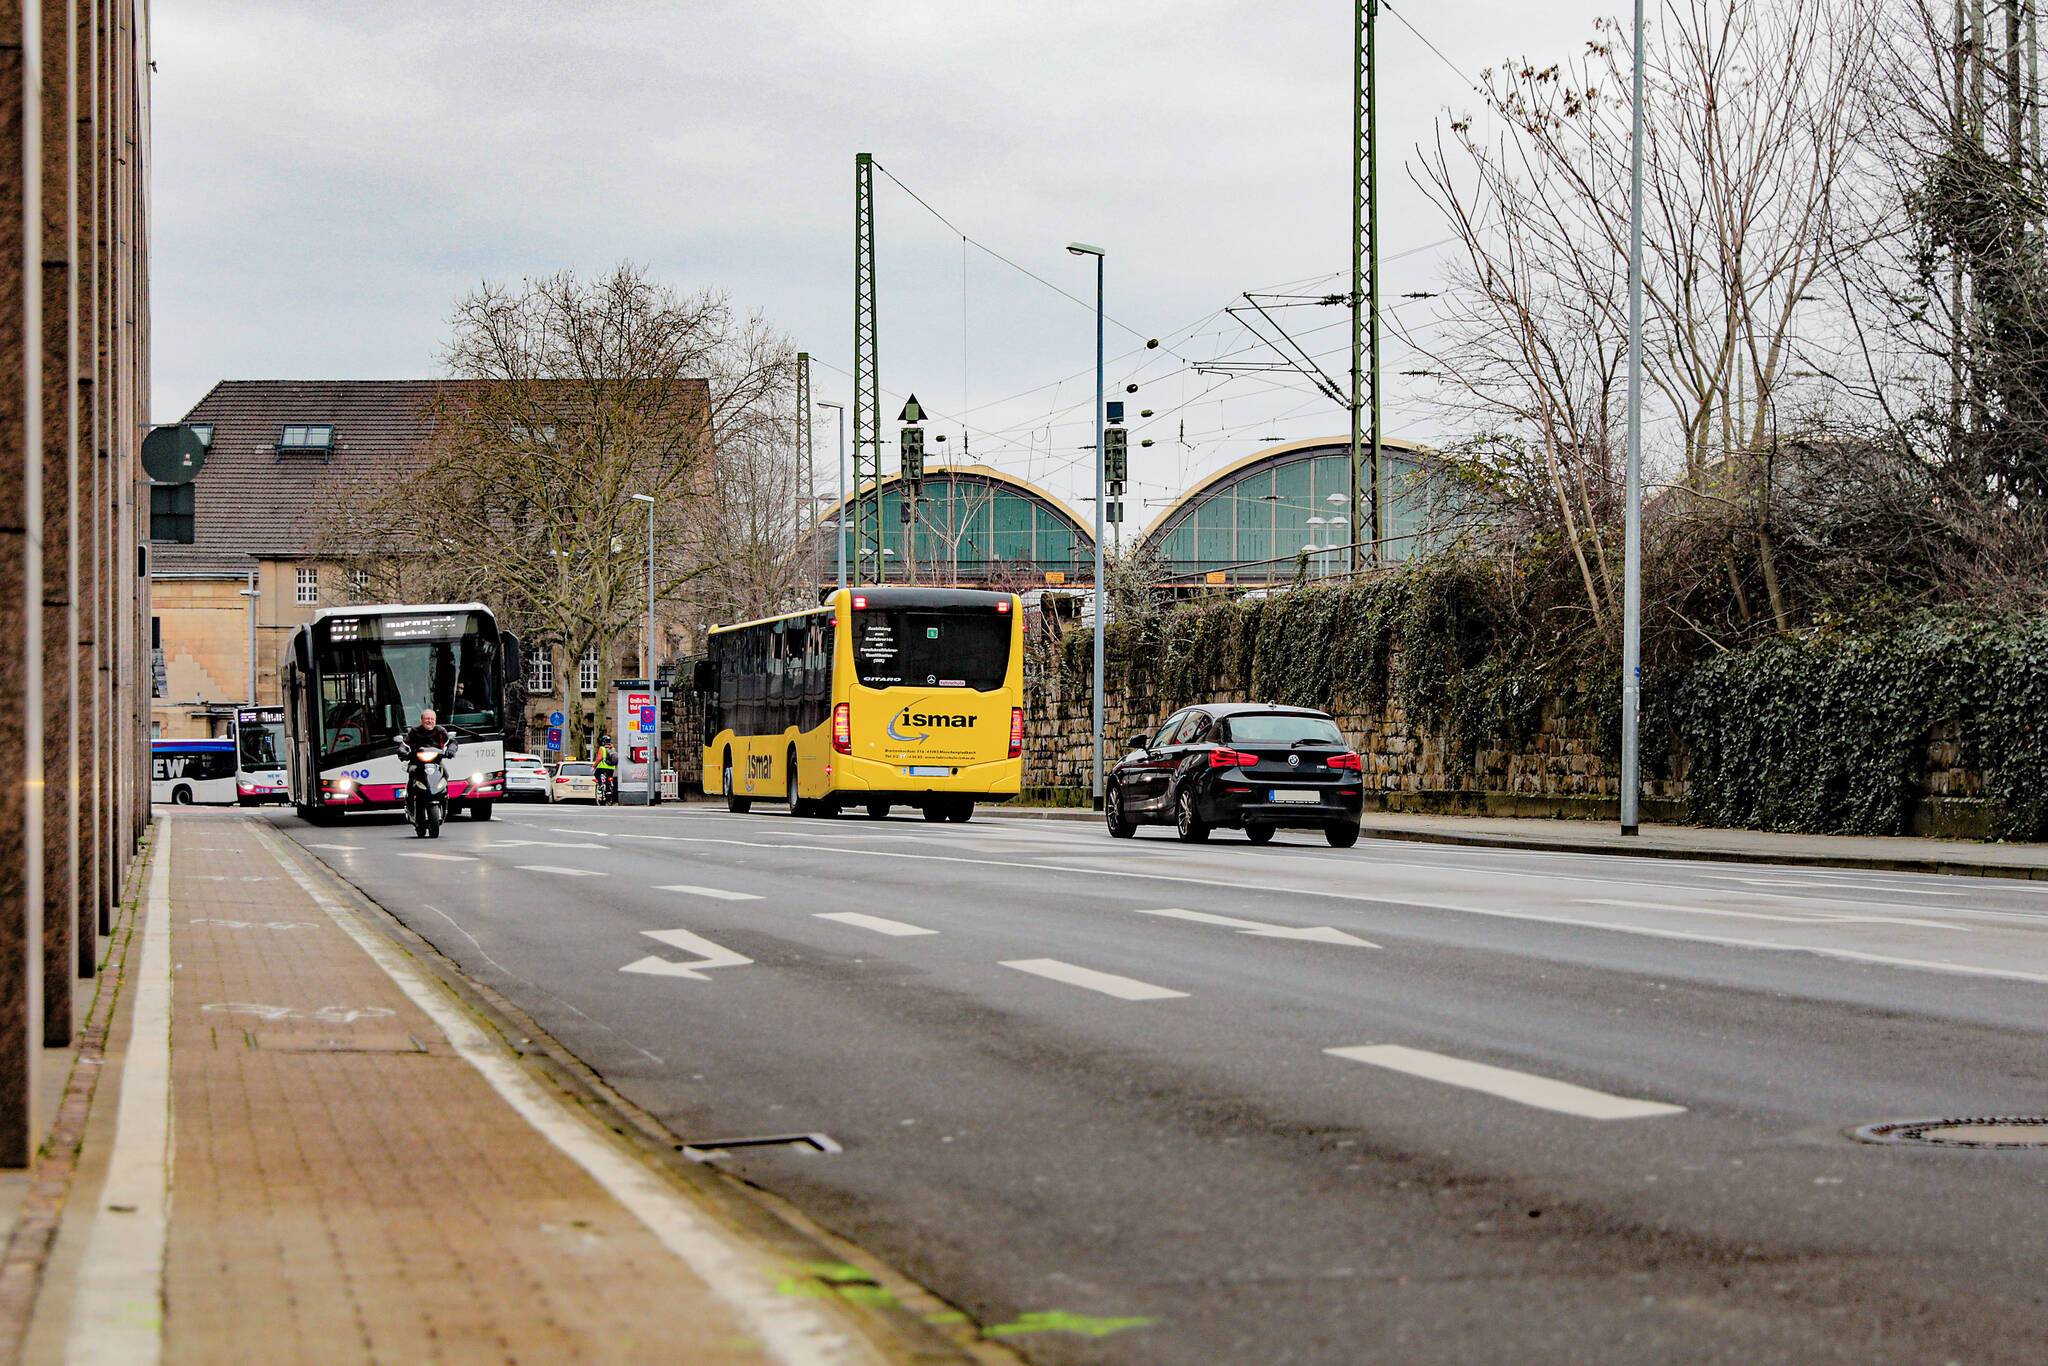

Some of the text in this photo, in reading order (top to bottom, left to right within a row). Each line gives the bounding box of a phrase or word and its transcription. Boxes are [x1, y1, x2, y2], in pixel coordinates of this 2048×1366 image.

[902, 707, 978, 728] ismar
[548, 742, 560, 750] TAXI
[475, 749, 497, 759] 1702
[748, 742, 772, 779] ismar
